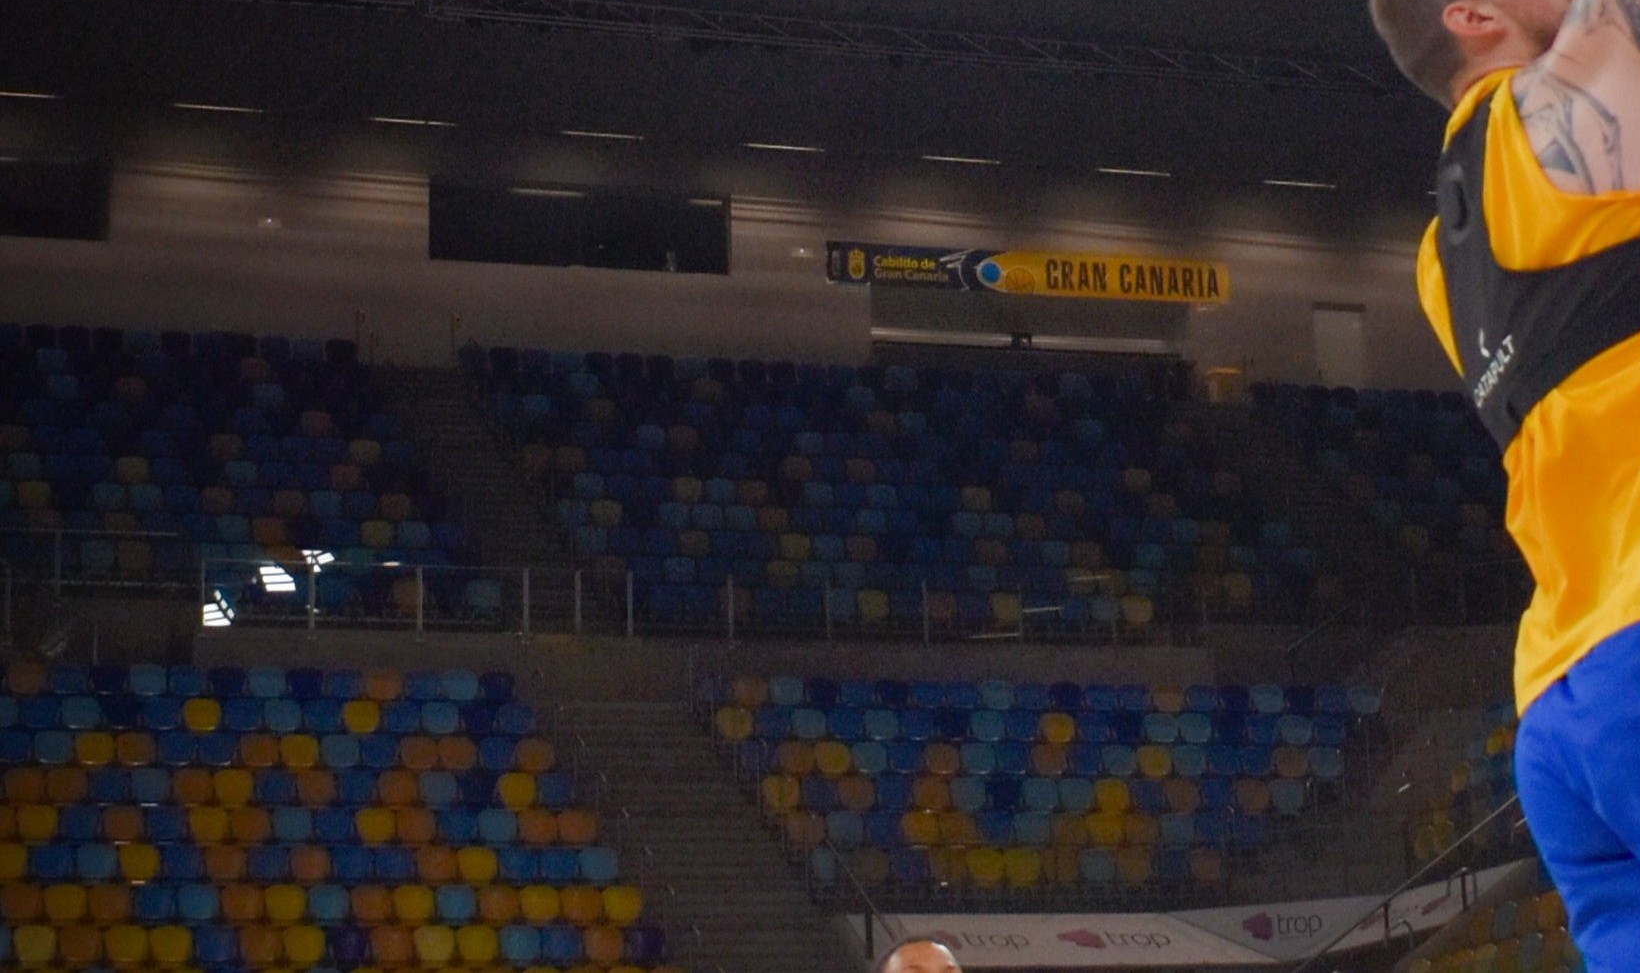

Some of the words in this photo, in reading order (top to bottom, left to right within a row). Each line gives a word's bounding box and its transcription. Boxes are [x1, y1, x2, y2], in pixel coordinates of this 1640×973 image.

[873, 255, 918, 269] Cabildo
[920, 257, 936, 270] de
[1046, 258, 1107, 292] GRAN
[1119, 263, 1220, 298] CANARIA
[1277, 913, 1322, 938] trop
[962, 931, 1030, 951] trop
[1104, 930, 1171, 950] trop
